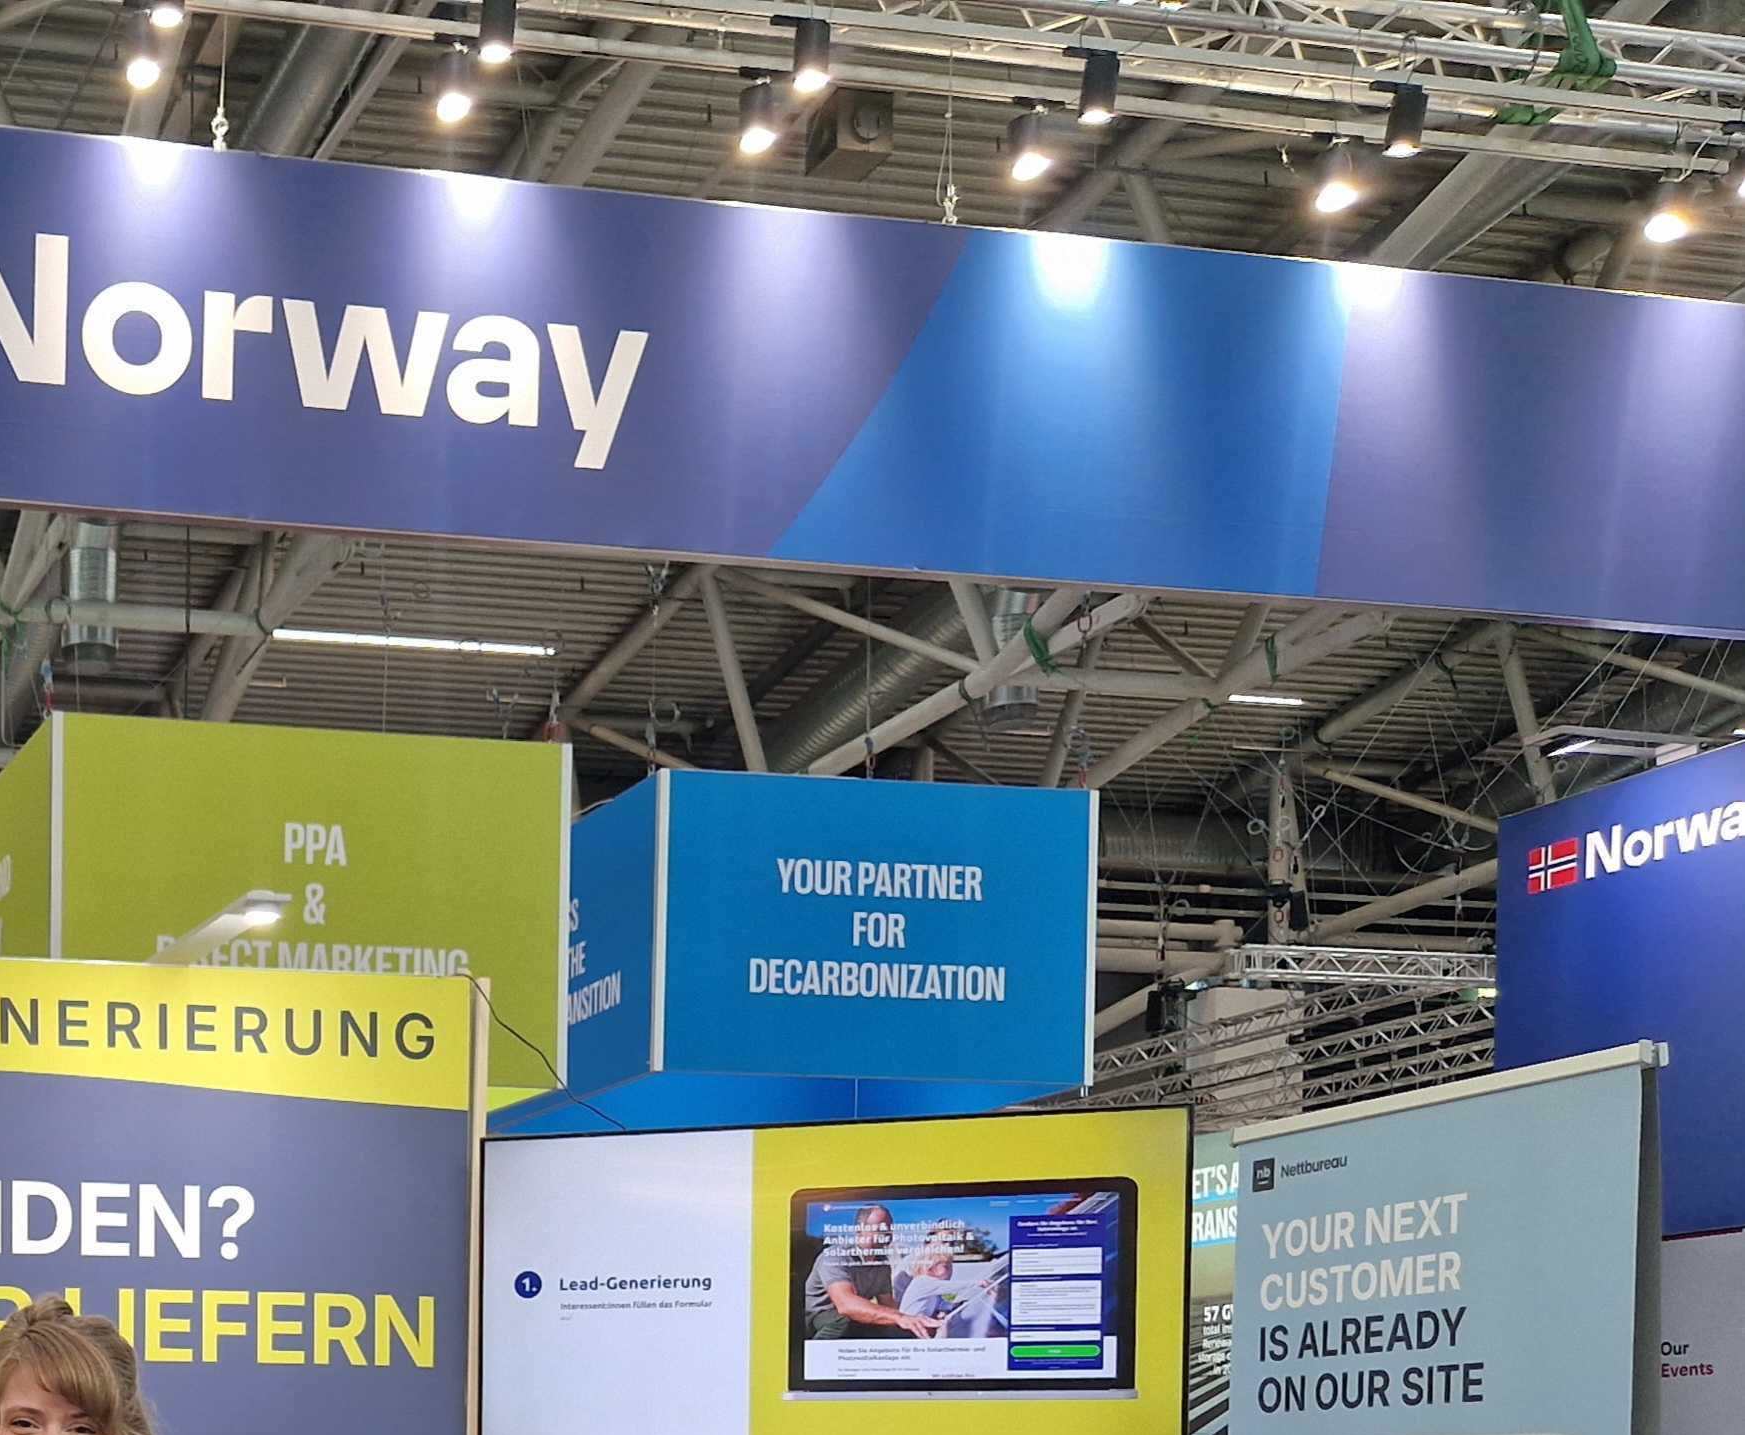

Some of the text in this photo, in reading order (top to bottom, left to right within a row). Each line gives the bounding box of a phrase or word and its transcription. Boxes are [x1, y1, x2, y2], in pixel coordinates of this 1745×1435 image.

[284, 822, 348, 866] PPA
[1585, 800, 1745, 879] Norwa
[777, 858, 983, 902] YOUR PARTNER
[303, 883, 326, 925] &
[853, 911, 905, 948] FOR
[278, 942, 469, 977] MARKETING
[749, 957, 1005, 1003] DECARBONIZATION
[1280, 1155, 1348, 1179] Nettbureau
[823, 1234, 872, 1245] Anbieter
[891, 1219, 966, 1231] unverbindlich
[1262, 1192, 1469, 1260] YOUR NEXT
[521, 1275, 712, 1292] 1. Lead-Generierung
[1259, 1250, 1462, 1312] CUSTOMER
[1203, 1305, 1220, 1322] 57
[1259, 1306, 1467, 1362] IS ALREADY
[1660, 1341, 1689, 1356] Our
[1258, 1362, 1485, 1414] ON OUR SITE
[1661, 1362, 1714, 1378] Events
